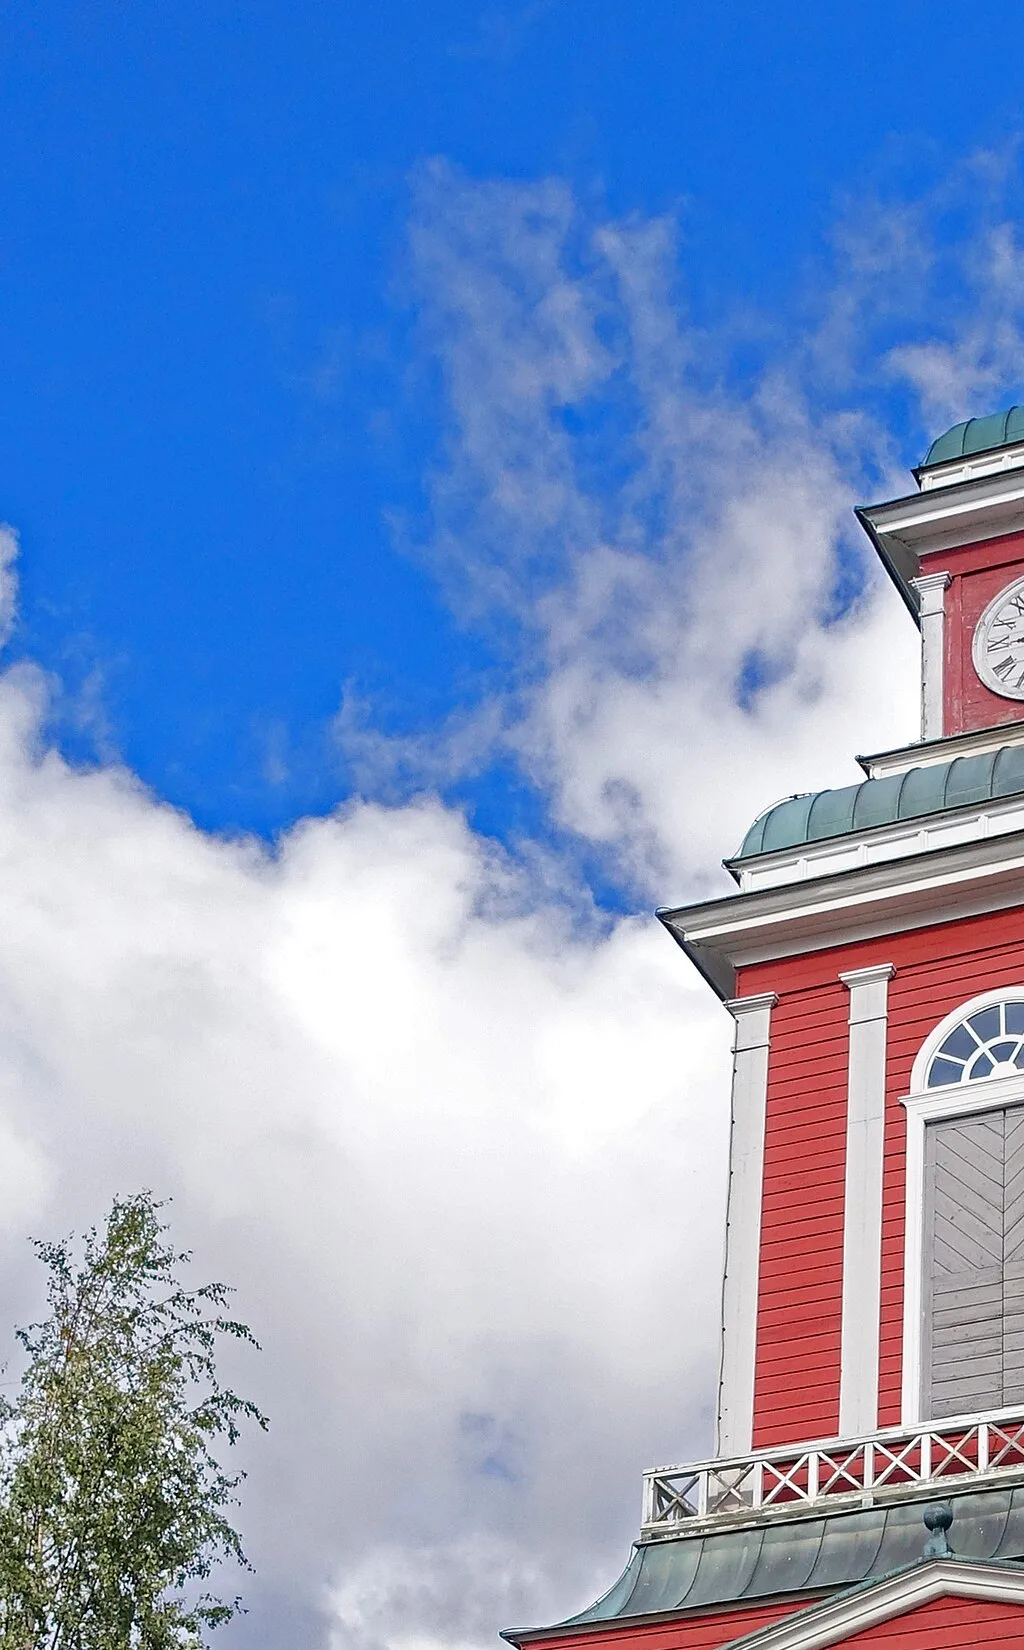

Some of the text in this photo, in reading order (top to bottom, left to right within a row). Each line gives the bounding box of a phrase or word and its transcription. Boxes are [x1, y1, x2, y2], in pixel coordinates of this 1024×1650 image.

[993, 618, 1016, 630] X
[987, 636, 1010, 652] IX
[992, 655, 1017, 682] VIII
